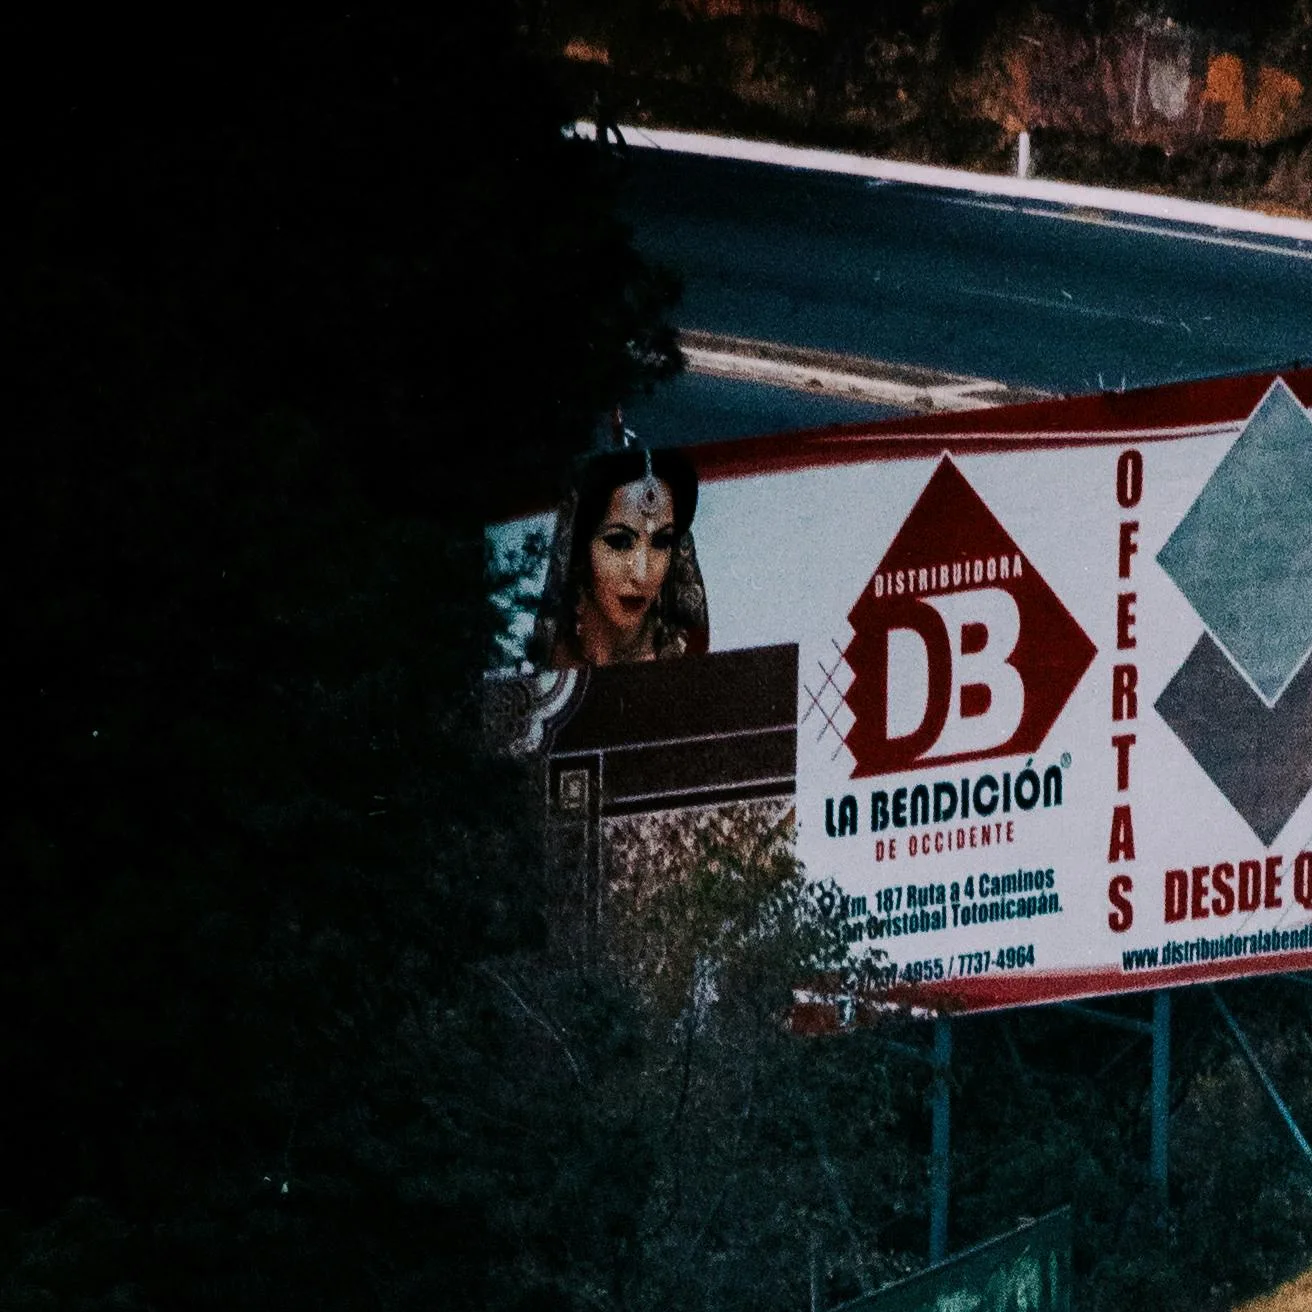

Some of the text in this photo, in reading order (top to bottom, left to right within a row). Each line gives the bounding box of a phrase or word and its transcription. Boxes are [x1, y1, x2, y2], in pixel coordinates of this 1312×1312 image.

[874, 554, 1023, 598] DISTRIBUIDORA
[884, 586, 1026, 762] DB
[1108, 449, 1143, 934] OFERTAS
[825, 793, 859, 837] LA
[875, 820, 1015, 862] DE OCCIDENTE
[875, 886, 903, 914] 187
[906, 882, 947, 909] Ruta
[950, 880, 961, 902] a
[964, 875, 975, 900] 4
[979, 867, 1056, 899] Caminos
[1165, 855, 1284, 925] DESDE
[957, 944, 1036, 977] 7737-4964
